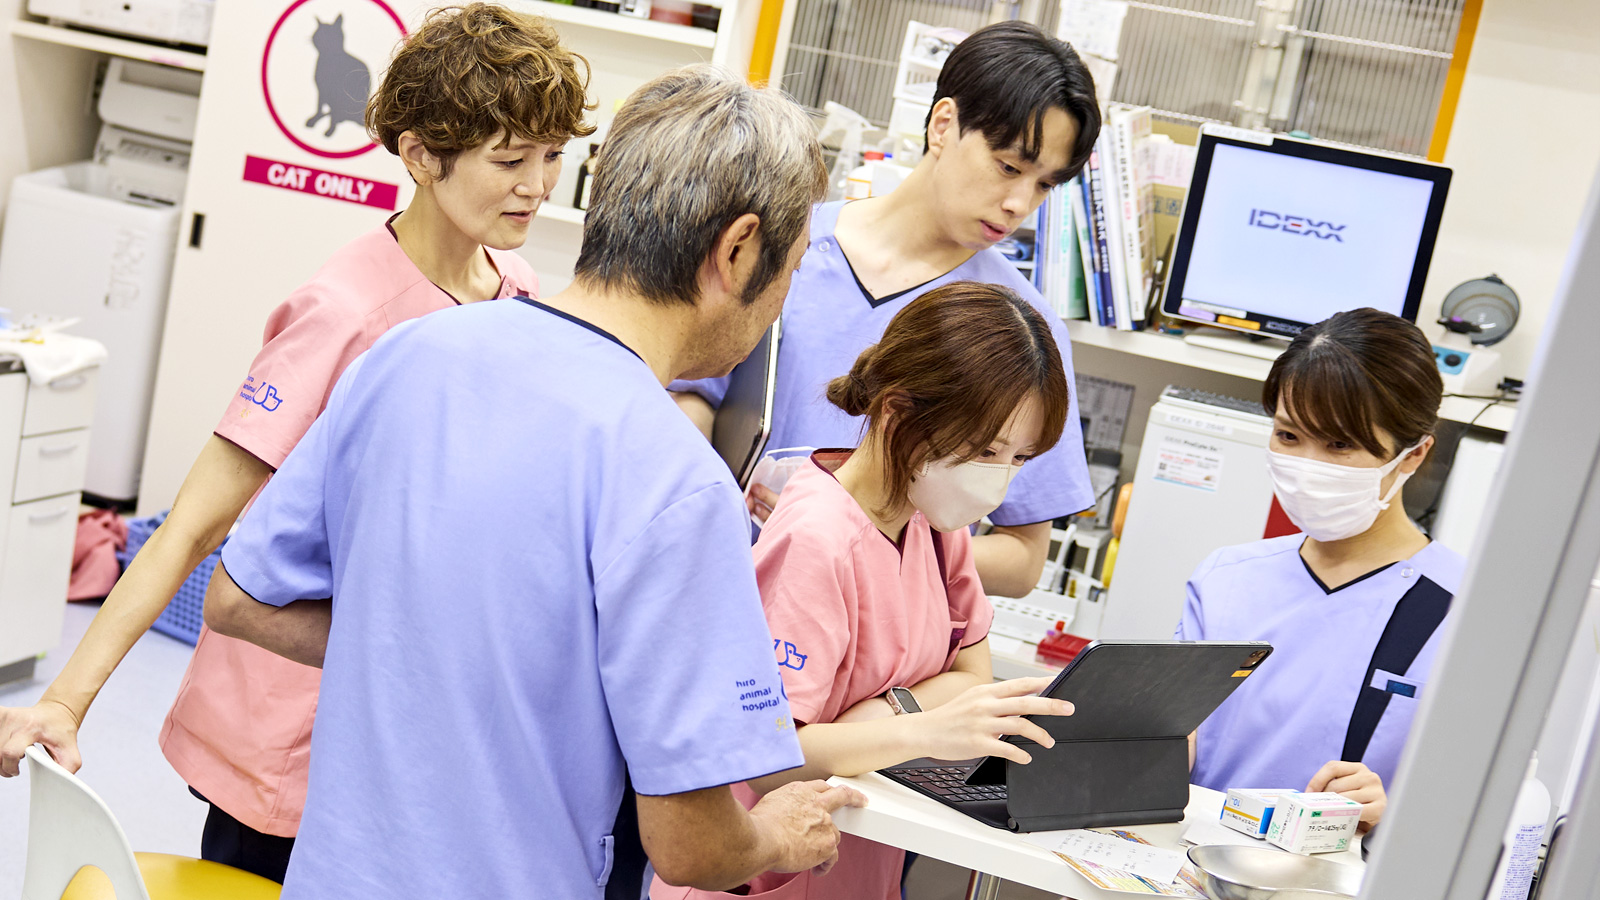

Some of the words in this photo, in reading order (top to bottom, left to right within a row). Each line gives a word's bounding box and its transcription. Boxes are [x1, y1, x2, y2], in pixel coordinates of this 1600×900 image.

[267, 163, 312, 190] CAT
[314, 173, 374, 203] ONLY
[1249, 208, 1346, 243] IDEXX
[736, 679, 756, 688] hiro
[740, 686, 772, 701] animal
[742, 696, 780, 711] hospital
